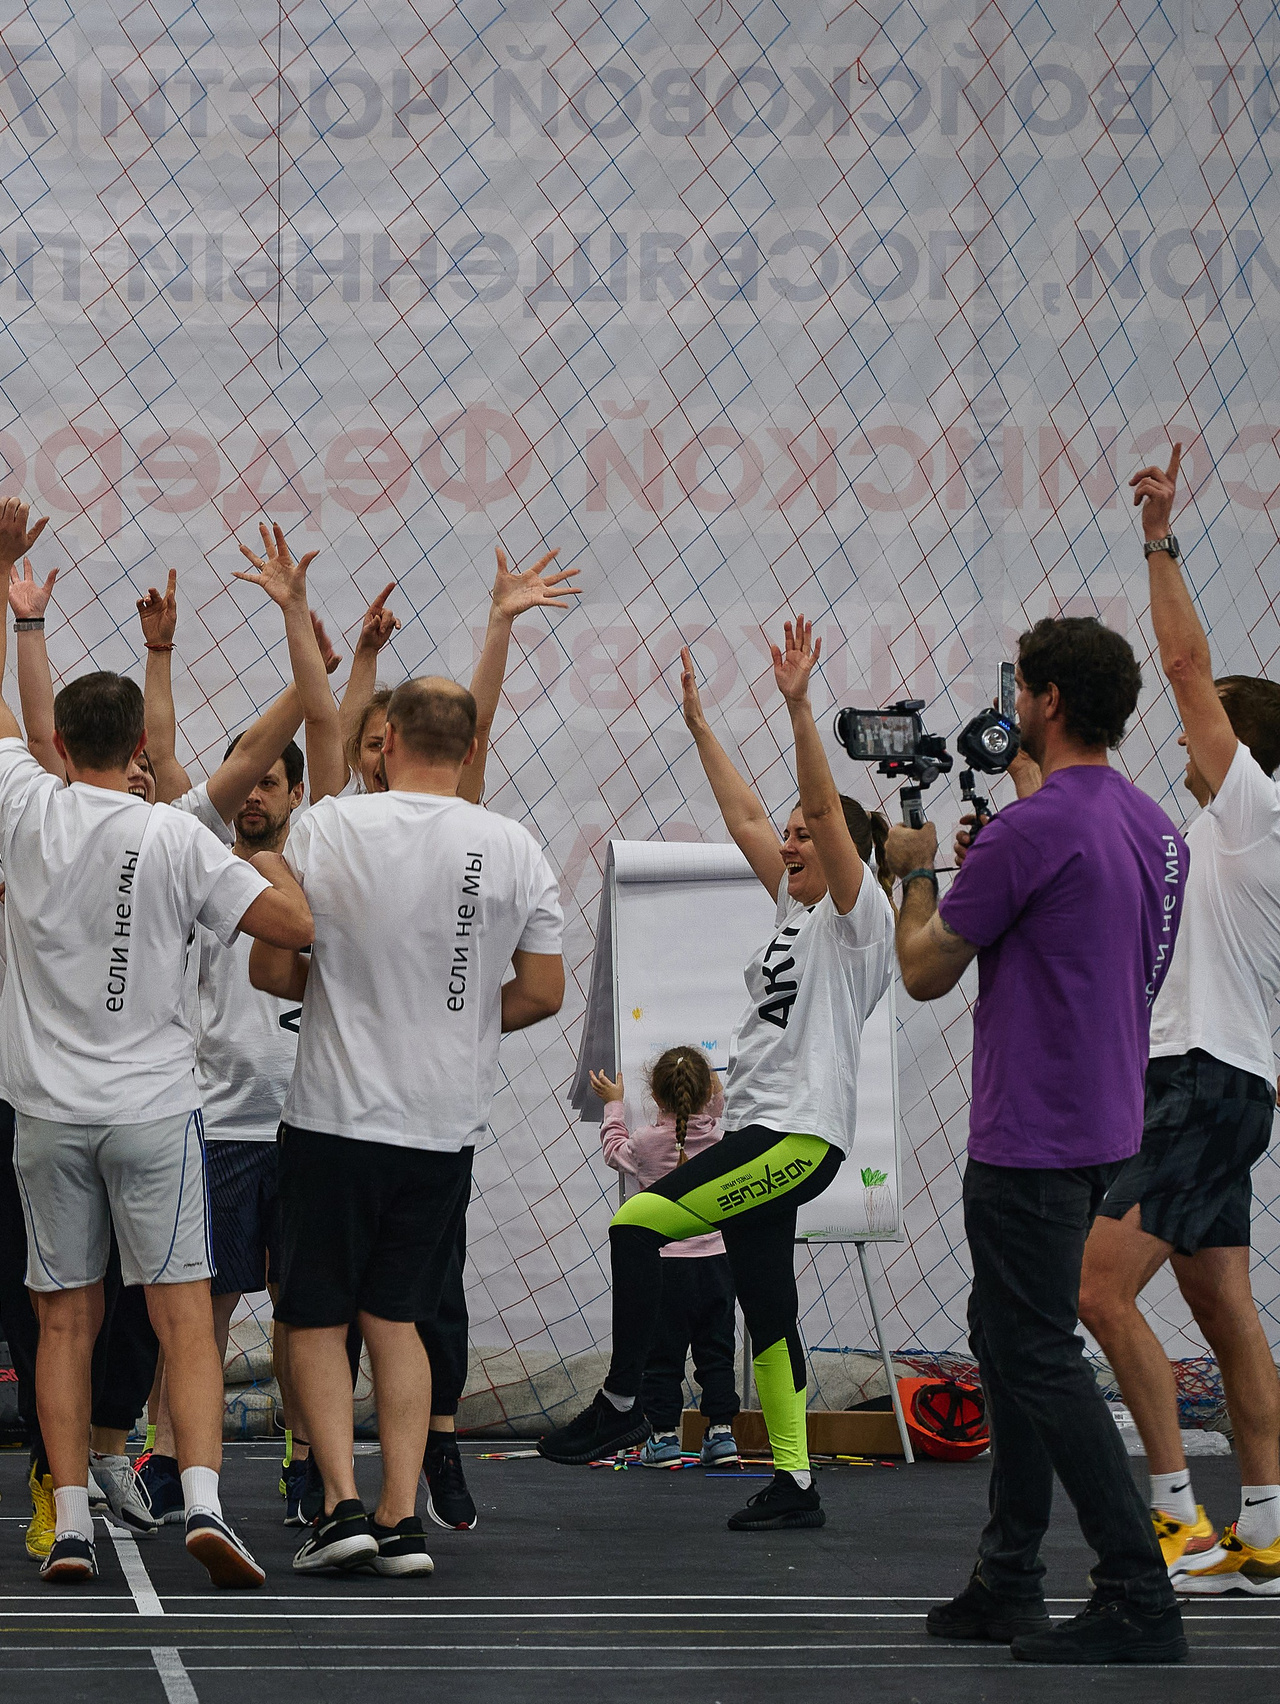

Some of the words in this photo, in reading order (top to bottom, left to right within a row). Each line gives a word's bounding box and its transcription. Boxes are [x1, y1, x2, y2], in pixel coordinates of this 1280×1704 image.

[118, 850, 139, 895] мы
[462, 852, 483, 896] мы
[1162, 835, 1179, 884] мы
[114, 903, 131, 937] не
[455, 904, 476, 937] не
[1162, 894, 1176, 932] не
[106, 947, 129, 1012] если
[446, 947, 469, 1012] если
